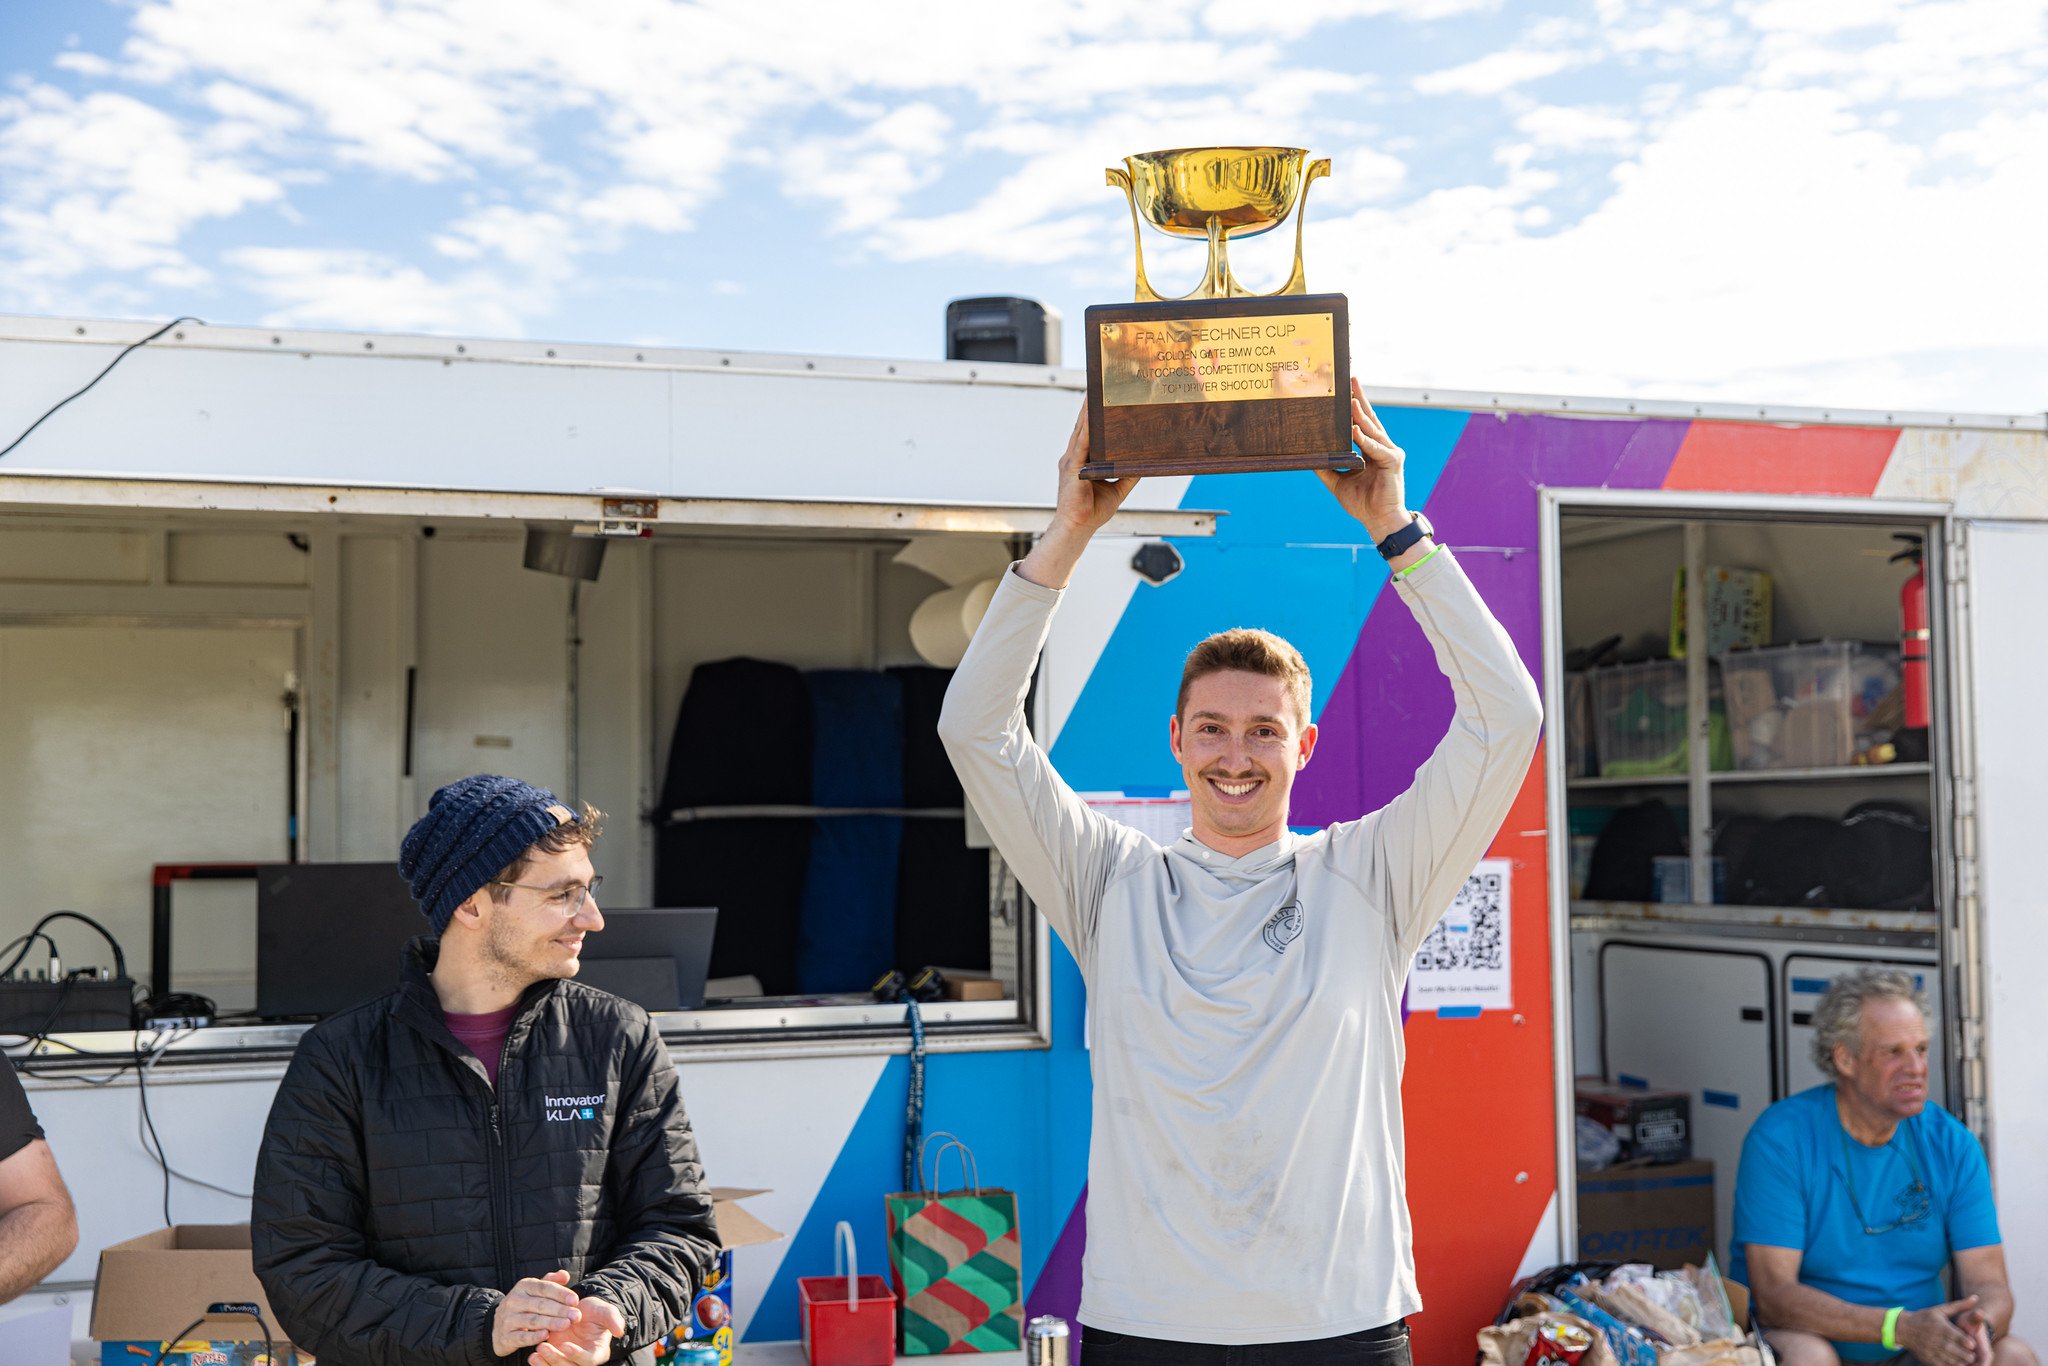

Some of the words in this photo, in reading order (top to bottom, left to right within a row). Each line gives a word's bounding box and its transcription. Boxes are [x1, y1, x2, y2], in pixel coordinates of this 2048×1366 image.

[1135, 329, 1188, 345] FRANZ
[1190, 325, 1261, 342] FECHNER
[1265, 324, 1296, 338] CUP
[1157, 349, 1198, 361] GOLDEN
[1199, 347, 1226, 359] GATE
[1228, 346, 1253, 358] BMW
[1254, 345, 1276, 357] CCA
[1136, 366, 1196, 379] AUTOCROSS
[1198, 363, 1264, 376] COMPETITION
[1266, 360, 1300, 373] SERIES
[1161, 383, 1182, 394] TOP
[1183, 381, 1218, 393] DRIVER
[1220, 378, 1275, 391] SHOOTOUT
[1266, 909, 1290, 930] SALTY
[544, 1094, 606, 1107] Innovator
